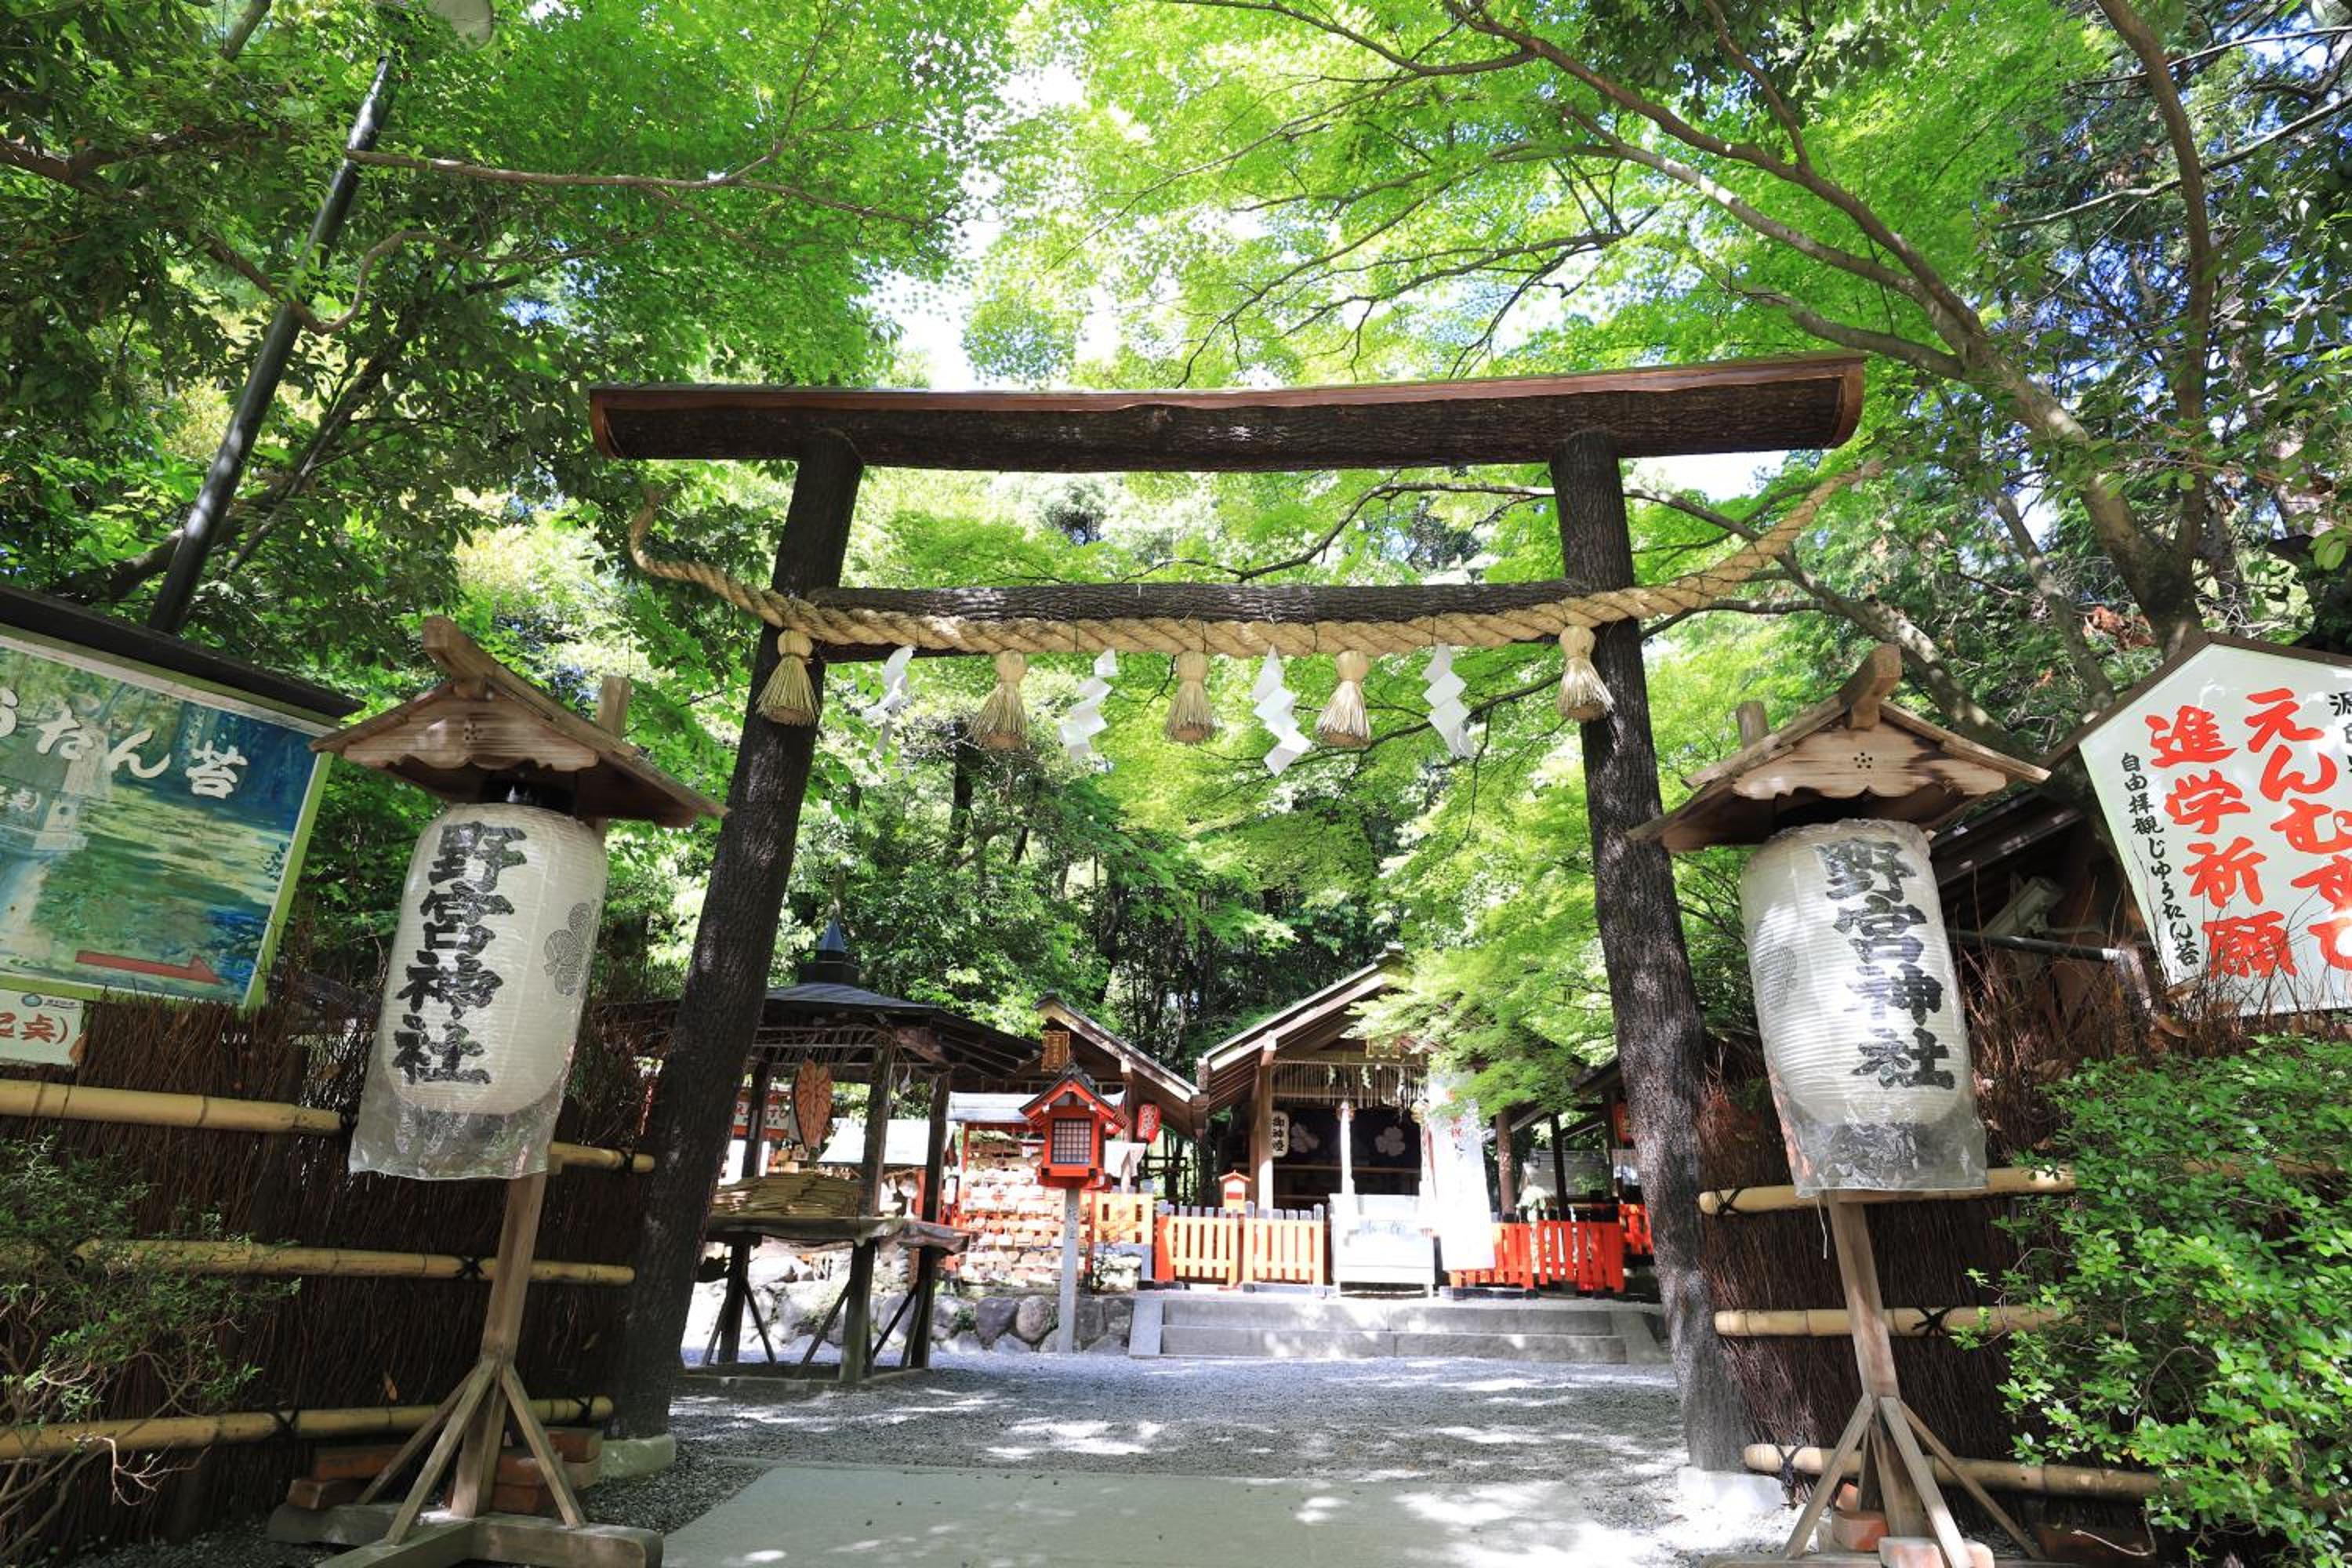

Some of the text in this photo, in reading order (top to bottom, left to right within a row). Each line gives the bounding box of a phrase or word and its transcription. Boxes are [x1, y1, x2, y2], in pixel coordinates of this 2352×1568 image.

[392, 821, 528, 1085] 野宮神社
[1816, 837, 1955, 1089] 野宮神社
[2145, 705, 2297, 978] 進学祈願
